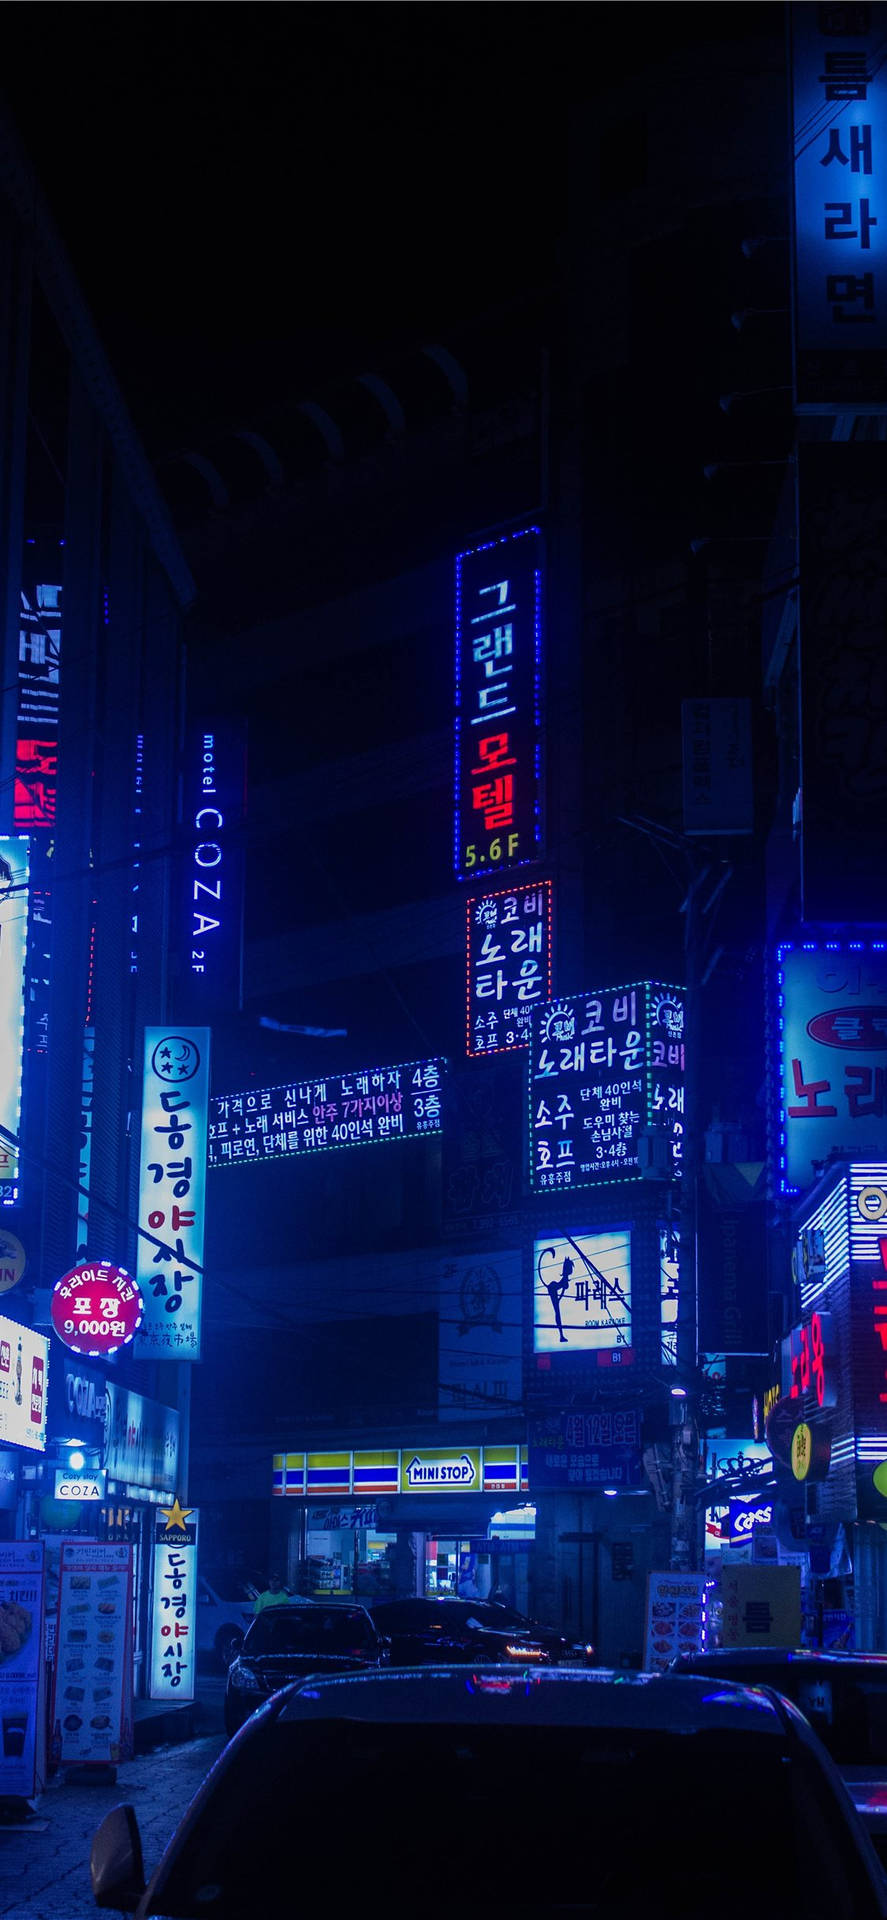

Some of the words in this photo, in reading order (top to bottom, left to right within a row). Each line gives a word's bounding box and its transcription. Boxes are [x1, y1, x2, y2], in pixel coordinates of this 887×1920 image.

[470, 579, 517, 725] 그랜드
[203, 734, 217, 793] motel
[470, 731, 518, 831] 모텔
[465, 832, 520, 867] 5.6F
[192, 808, 223, 936] COZA
[501, 889, 544, 924] 코비
[475, 921, 543, 966] 노래
[191, 950, 205, 974] 2F
[475, 959, 542, 1000] 타운
[474, 1011, 499, 1030] 소주
[581, 990, 637, 1035] 코비
[474, 1033, 499, 1051] 호프
[534, 1030, 645, 1079] 노래타운
[652, 1040, 685, 1071] 코비
[411, 1064, 440, 1088] 4층
[218, 1093, 272, 1118] 가격으로
[284, 1083, 327, 1107] 신나게
[341, 1070, 401, 1096] 노래하자
[413, 1095, 441, 1118] 3층
[580, 1086, 603, 1101] 단체
[600, 1096, 621, 1111] 완비
[245, 1113, 268, 1134] 노래
[272, 1108, 309, 1128] 서비스
[312, 1102, 339, 1124] 안주
[534, 1094, 574, 1130] 소주
[583, 1113, 615, 1130] 도우미
[263, 1131, 299, 1154] 단체를
[303, 1125, 328, 1147] 위한
[331, 1119, 374, 1140] 40인석
[377, 1113, 404, 1134] 완비
[535, 1140, 575, 1171] 호프
[148, 1091, 198, 1314] 동경야시장
[64, 1320, 126, 1338] 9,000원
[60, 1484, 99, 1497] COZA
[62, 1472, 82, 1481] Cozy
[159, 1533, 192, 1543] SAPPORO
[160, 1553, 189, 1687] 동경야시장
